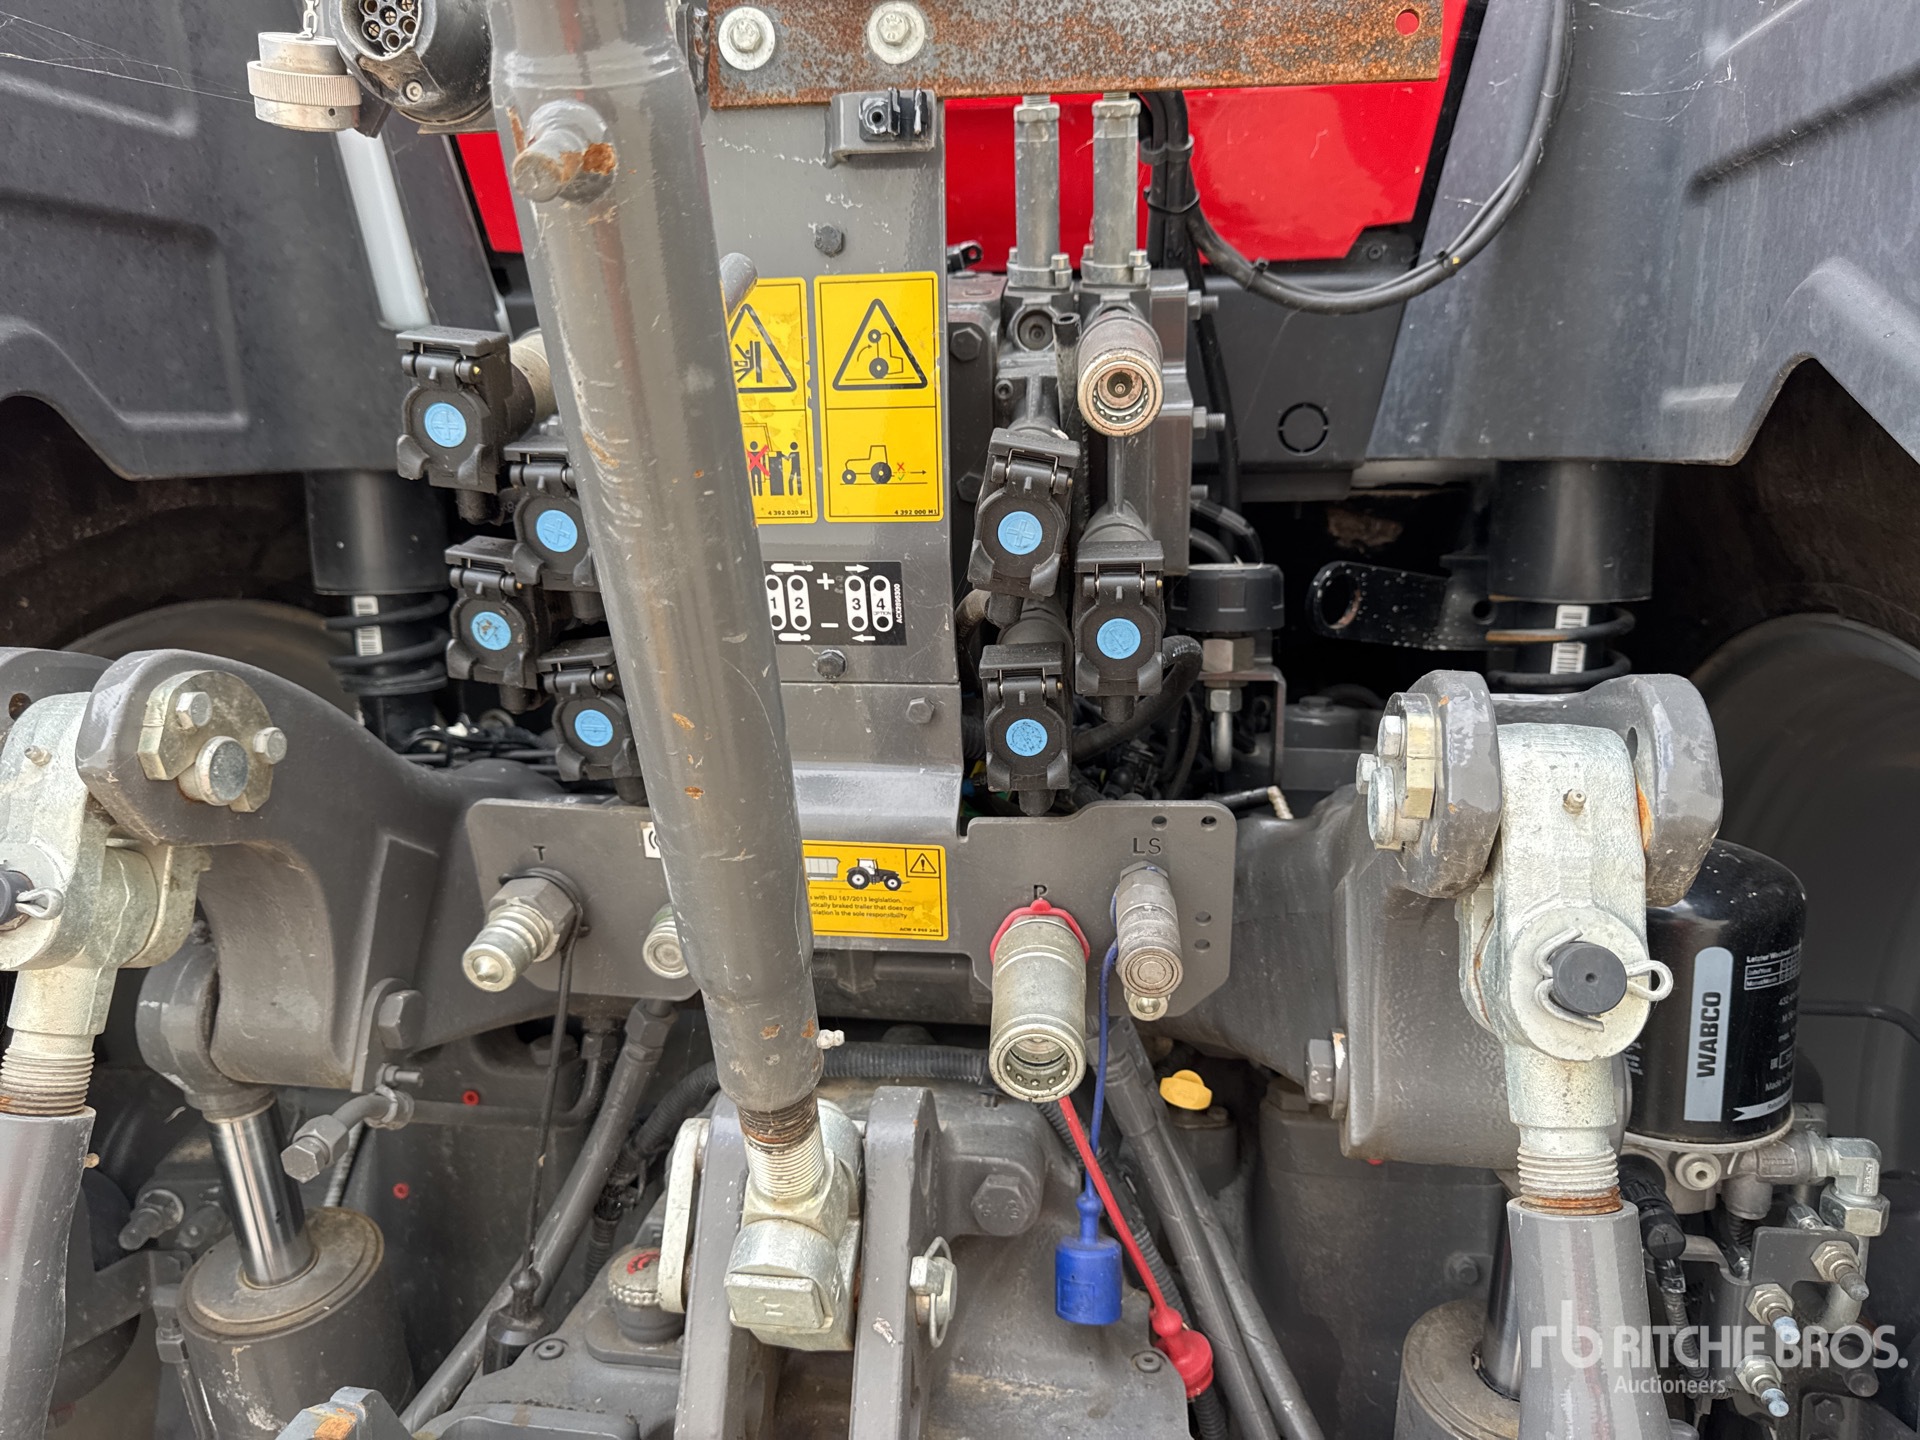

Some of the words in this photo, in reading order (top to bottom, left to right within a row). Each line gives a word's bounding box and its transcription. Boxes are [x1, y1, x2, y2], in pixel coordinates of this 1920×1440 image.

[770, 597, 777, 609] 1
[794, 597, 804, 609] 2
[852, 598, 861, 610] 3
[876, 598, 886, 610] 4
[533, 845, 546, 861] T
[1133, 837, 1162, 855] LS
[1033, 884, 1048, 900] P
[1696, 991, 1721, 1078] WABCO
